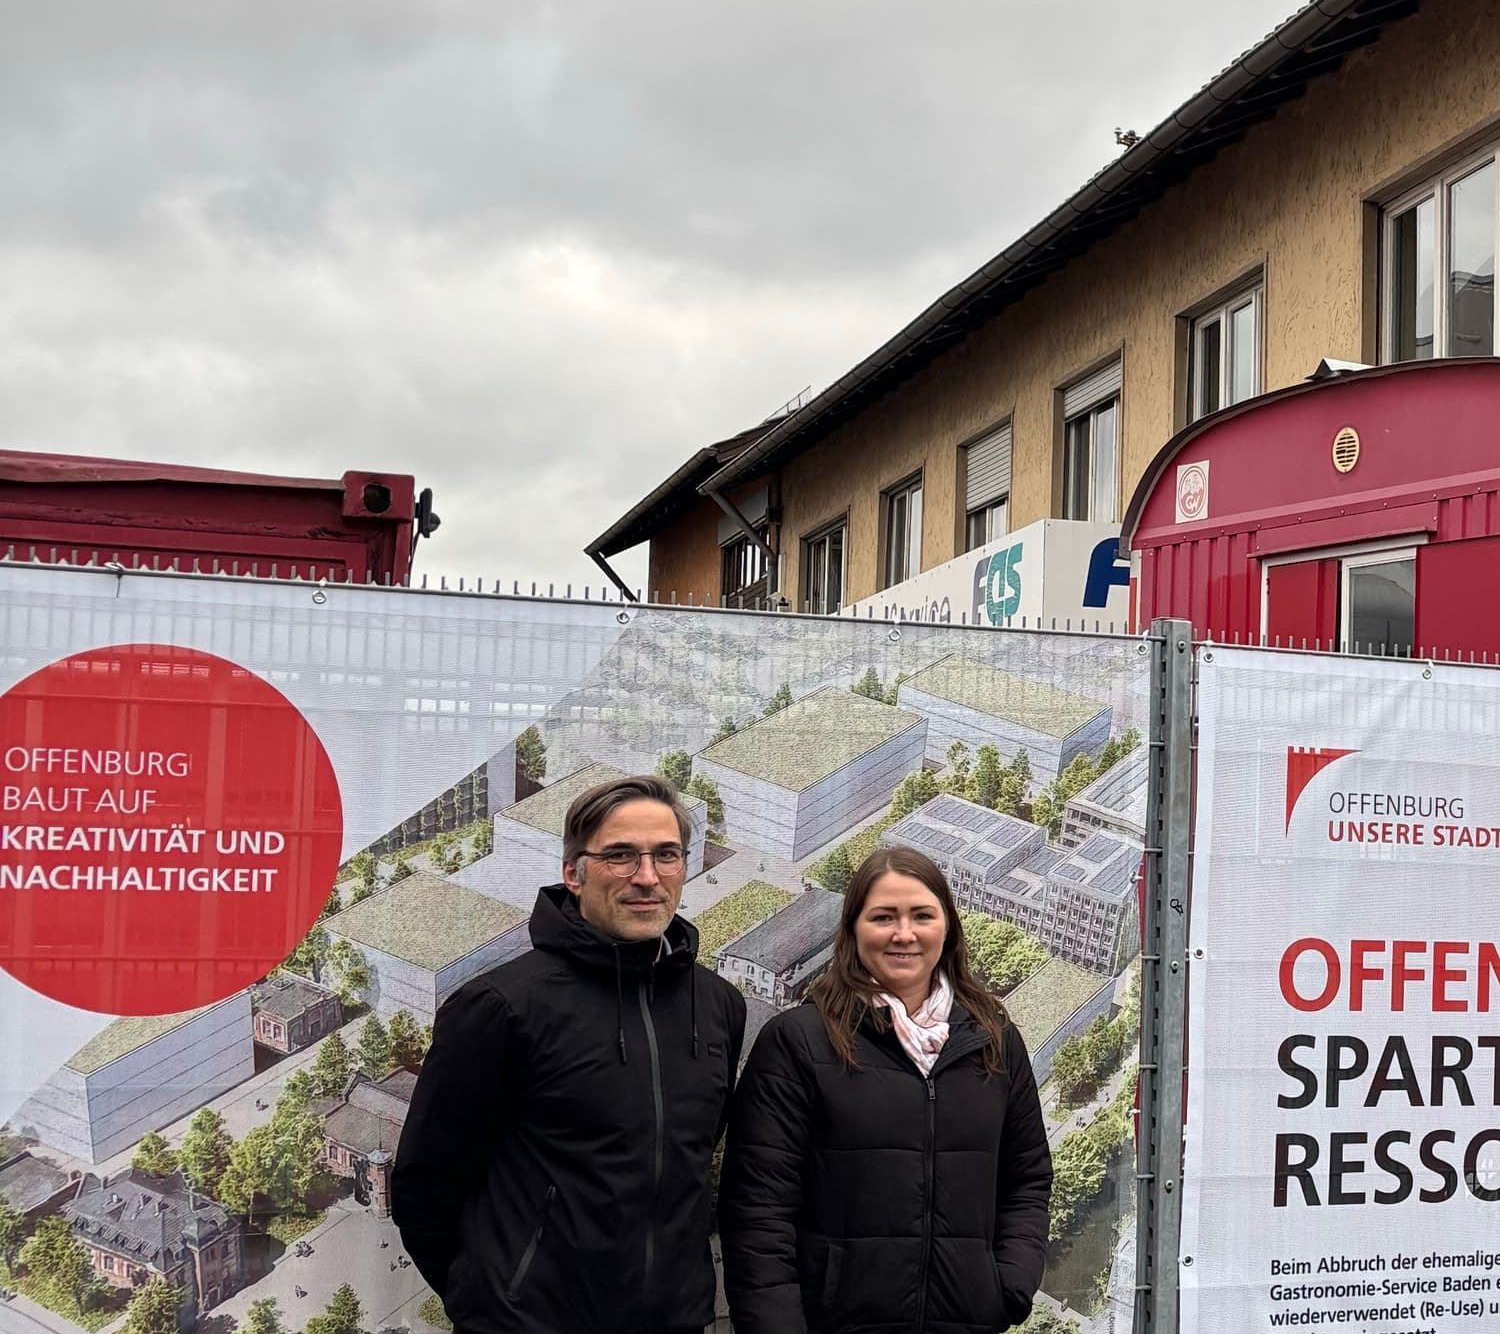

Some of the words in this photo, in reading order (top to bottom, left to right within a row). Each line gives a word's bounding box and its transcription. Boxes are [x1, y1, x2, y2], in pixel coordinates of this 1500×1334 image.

[5, 747, 187, 776] OFFENBURG
[4, 786, 88, 811] BAUT
[95, 789, 156, 813] AUF
[1330, 792, 1463, 818] OFFENBURG
[1, 824, 206, 853] KREATIVITÄT
[217, 831, 284, 854] UND
[1329, 821, 1424, 844] UNSERE
[0, 865, 277, 891] NACHHALTIGKEIT
[1271, 1258, 1311, 1275] Beim
[1317, 1255, 1385, 1273] Abbruch
[1392, 1253, 1417, 1270] der
[1270, 1278, 1437, 1303] Gastronomie-Service
[1443, 1275, 1490, 1292] Baden
[1270, 1303, 1415, 1326] wiederverwendet
[1421, 1299, 1484, 1320] (Re-Use)
